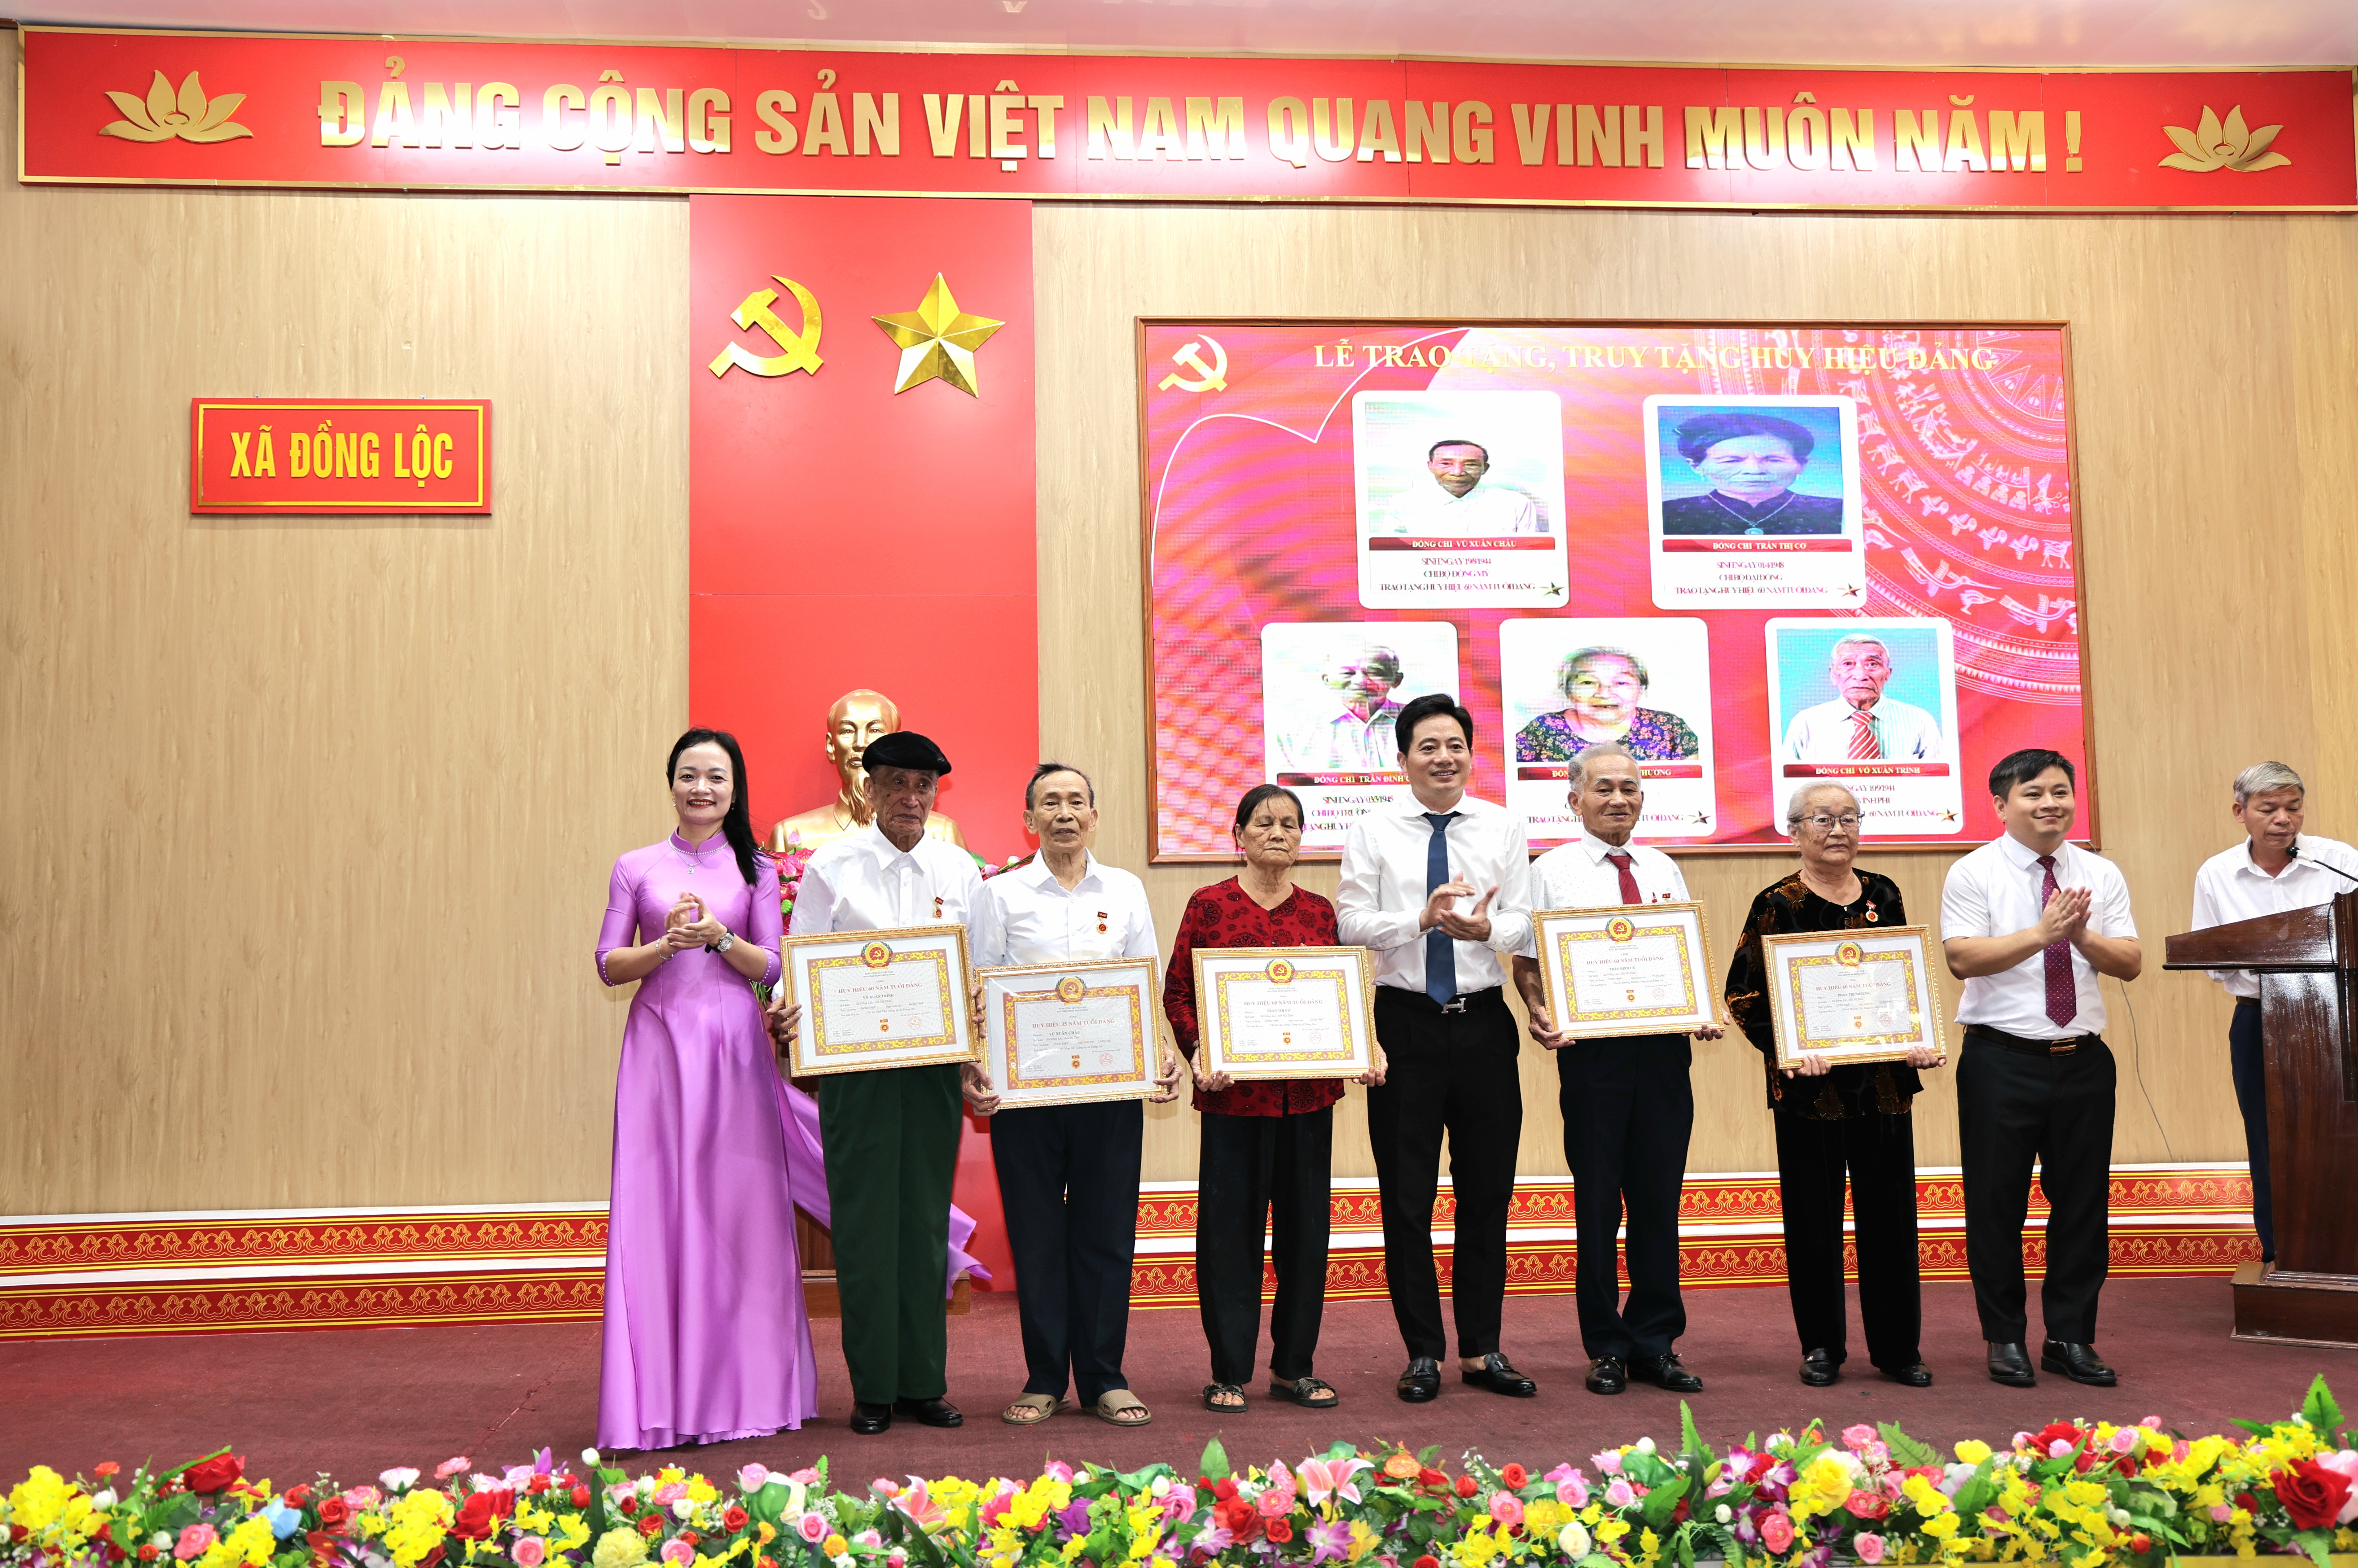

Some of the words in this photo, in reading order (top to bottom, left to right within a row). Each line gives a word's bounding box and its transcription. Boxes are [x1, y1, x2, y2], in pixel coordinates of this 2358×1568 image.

[319, 56, 522, 149] ĐẢNG
[544, 69, 732, 165] CỘNG
[755, 68, 900, 157] SẢN
[923, 80, 1064, 172] VIỆT
[1086, 95, 1246, 160] NAM
[1267, 96, 1494, 168] QUANG
[1511, 103, 1664, 167] VINH
[1685, 91, 1877, 172] MUÔN
[1894, 94, 2046, 172] NĂM
[1314, 338, 1355, 368] LỄ
[1363, 345, 1451, 368] TRAO
[1562, 346, 1649, 369] TRUY
[1655, 343, 1742, 374] TẶNG
[1750, 347, 1822, 369] HUY
[1823, 344, 1897, 376] HIỆU
[1907, 342, 1995, 370] ĐẢNG
[230, 424, 276, 477] XÃ
[289, 419, 379, 478] ĐỒNG
[394, 424, 453, 487] LỘC
